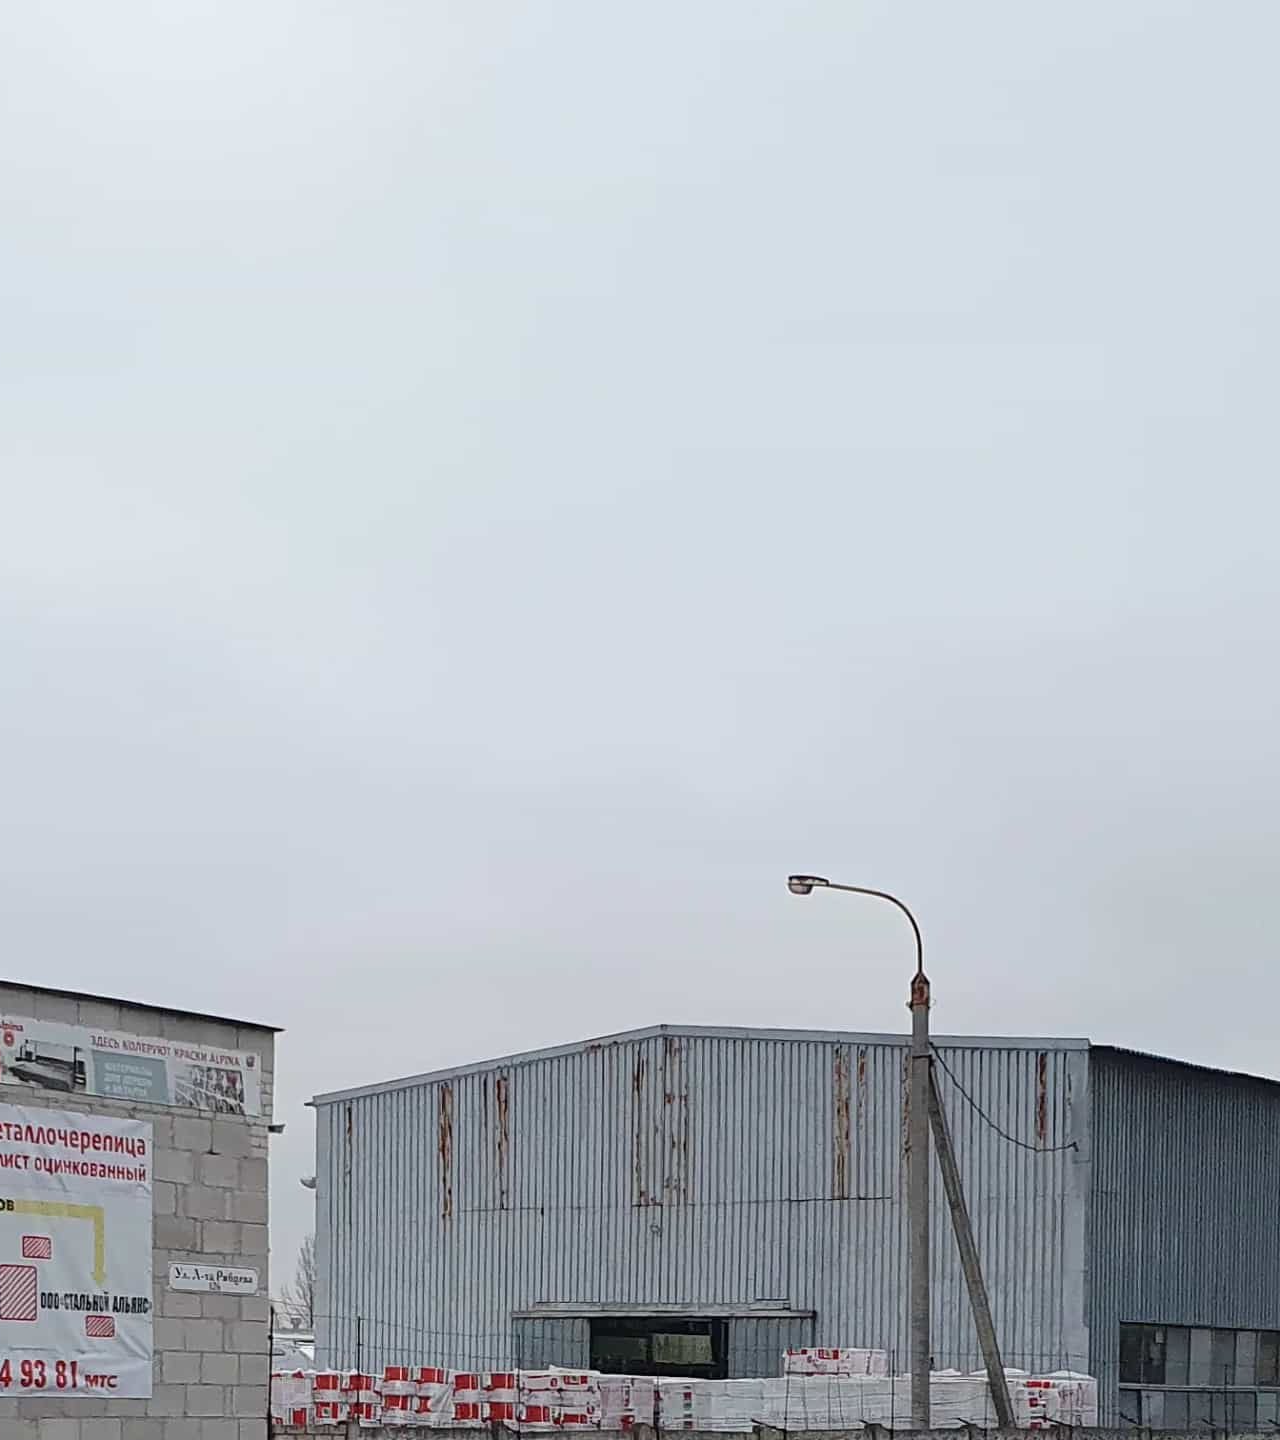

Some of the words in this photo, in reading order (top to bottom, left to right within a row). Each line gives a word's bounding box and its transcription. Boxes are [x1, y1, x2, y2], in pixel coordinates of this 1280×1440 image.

[90, 1035, 120, 1049] ЗДЕСЬ
[174, 1048, 207, 1063] КРАСКИ
[35, 1157, 147, 1182] оцинкованный
[20, 1359, 47, 1388] 93
[56, 1360, 79, 1388] 81
[84, 1373, 118, 1388] МТС
